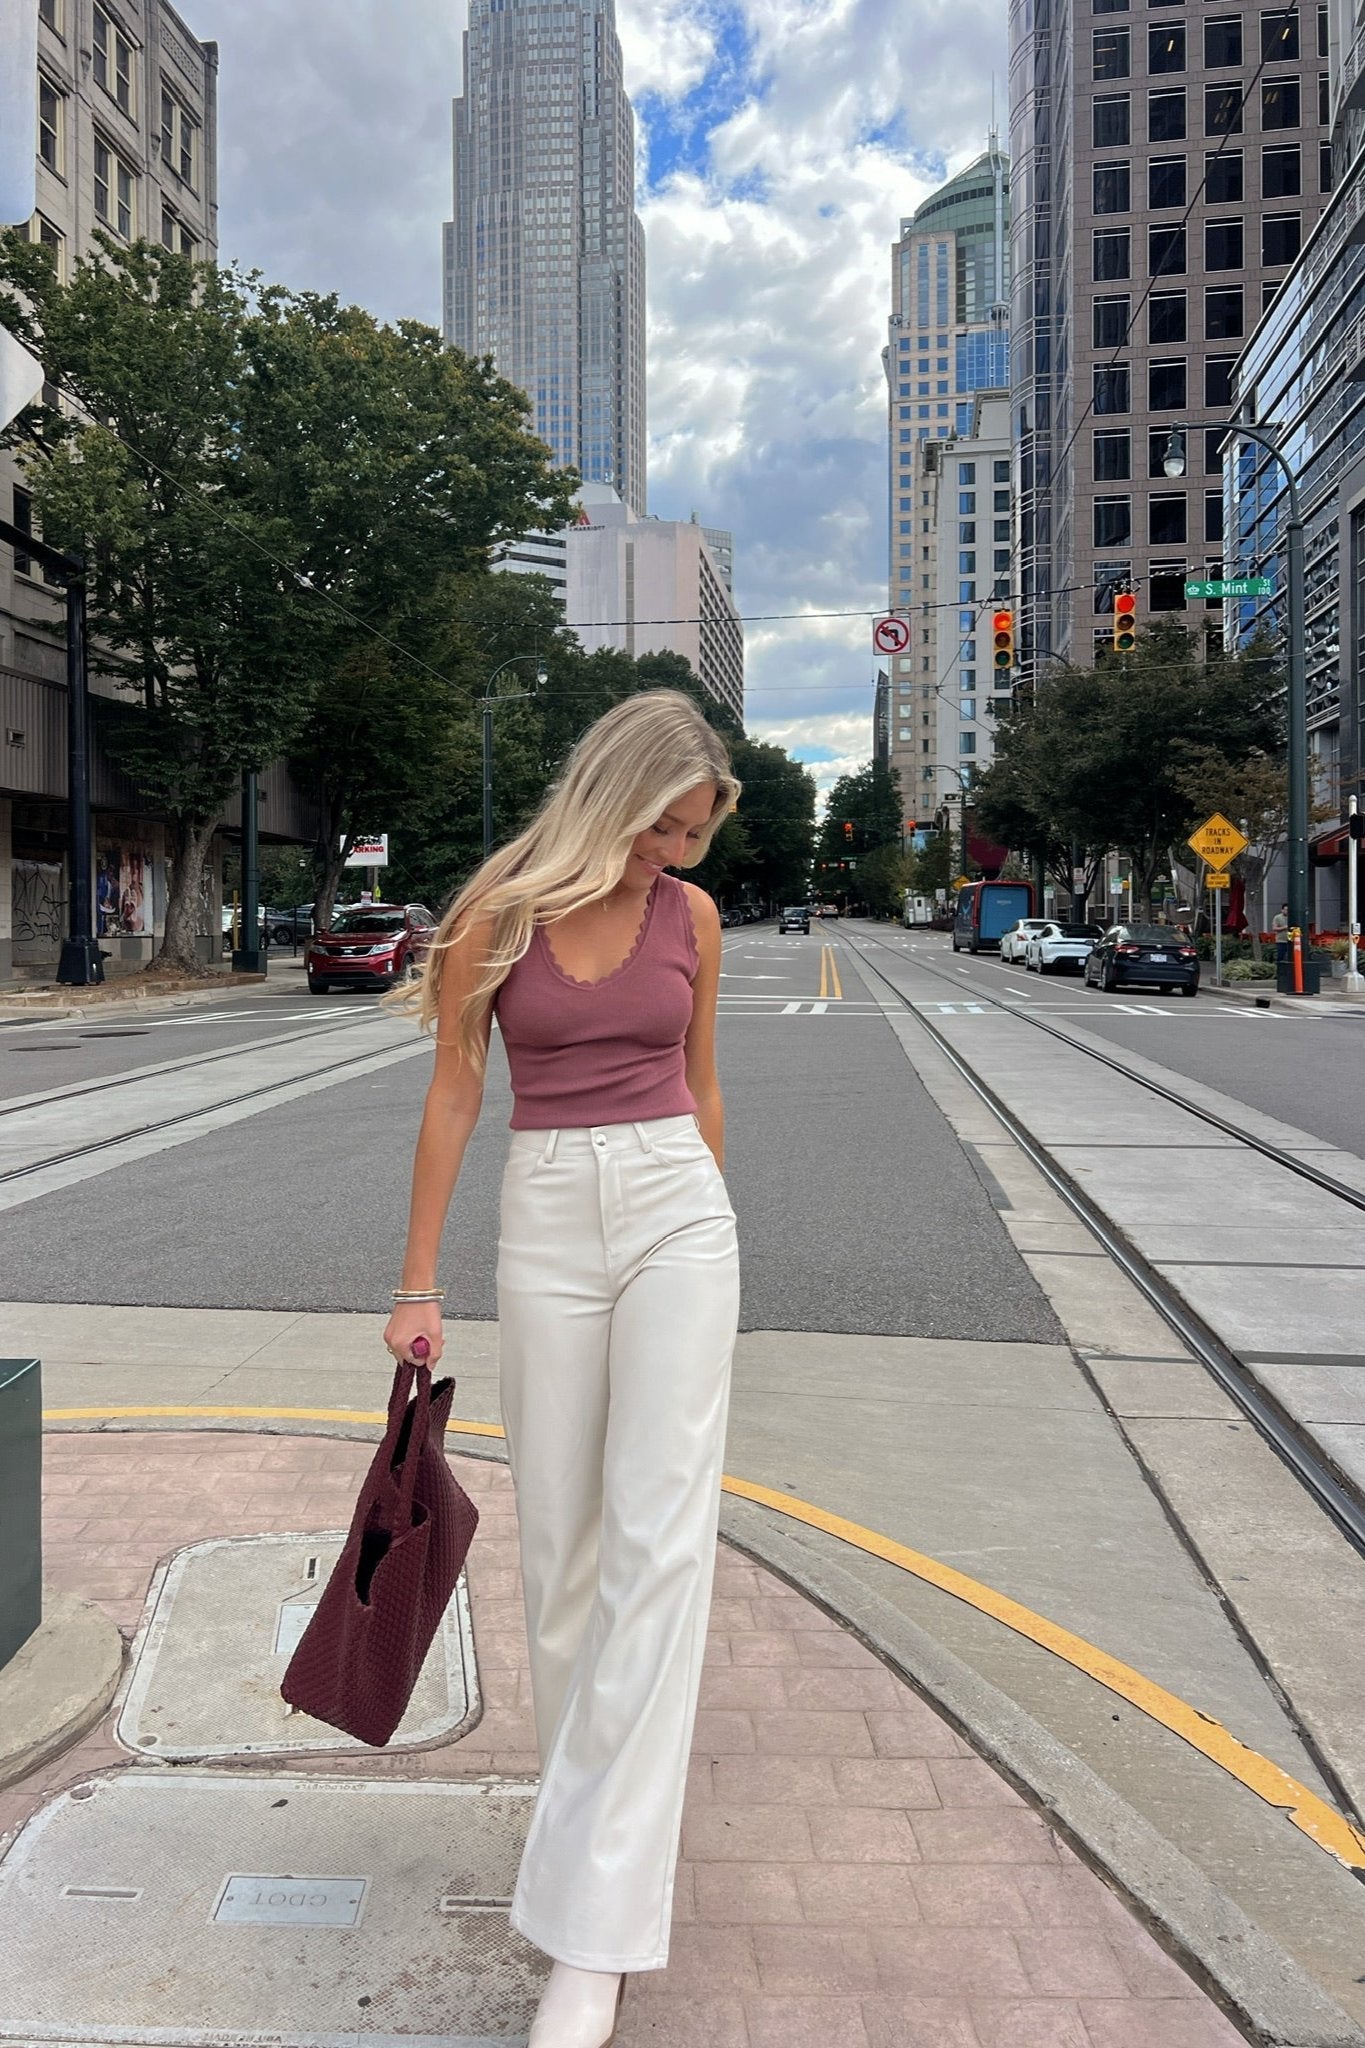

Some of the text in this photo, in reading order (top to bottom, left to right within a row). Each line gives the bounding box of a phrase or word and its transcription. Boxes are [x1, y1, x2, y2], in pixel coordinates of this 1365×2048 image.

[1205, 578, 1271, 595] S. Mint St
[1258, 587, 1271, 595] 100
[1206, 828, 1231, 836] TRACKS
[352, 845, 384, 853] ARKING
[1202, 847, 1234, 855] ROADWAY
[247, 1892, 328, 1907] CDOT
